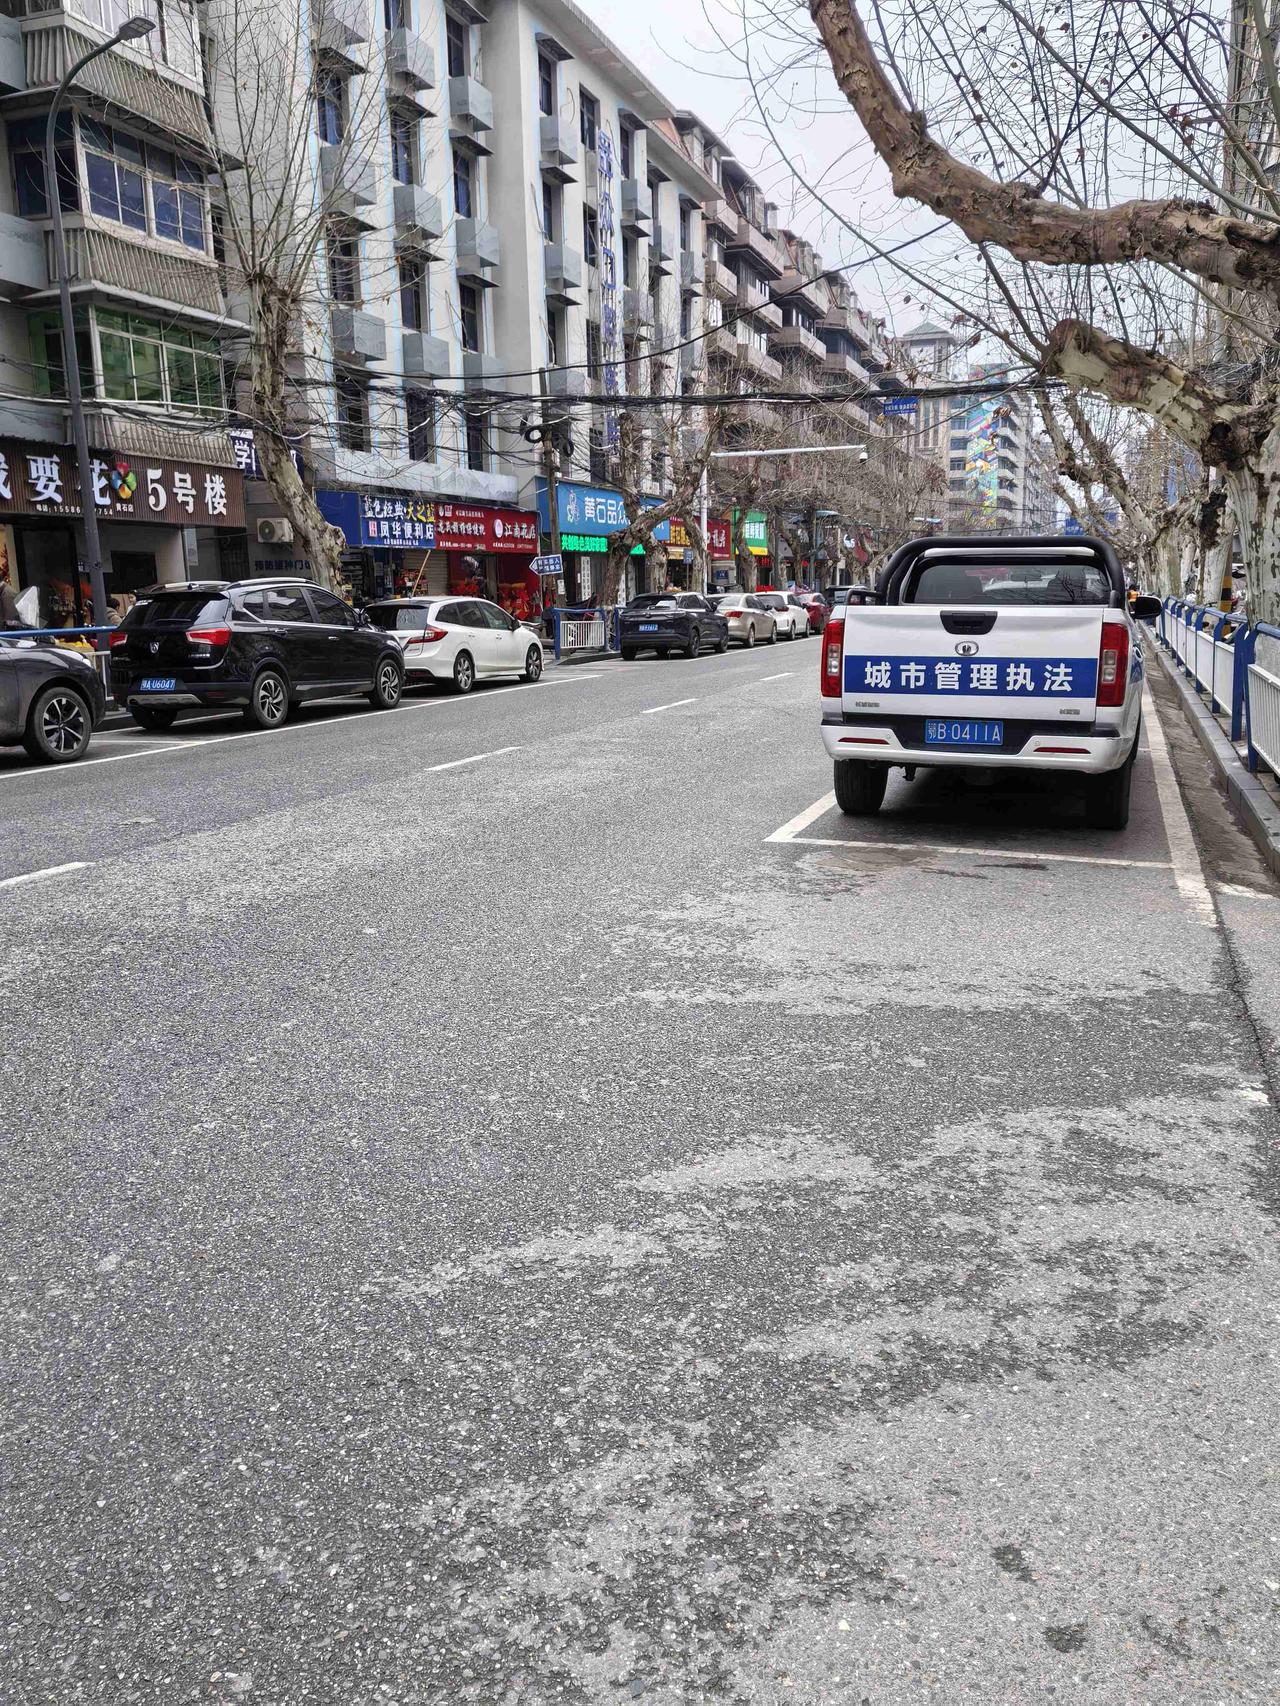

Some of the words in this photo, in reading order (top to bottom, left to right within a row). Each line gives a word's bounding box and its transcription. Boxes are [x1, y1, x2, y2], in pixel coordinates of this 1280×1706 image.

[147, 468, 227, 516] 5号楼
[864, 661, 1073, 691] 城市管理执法
